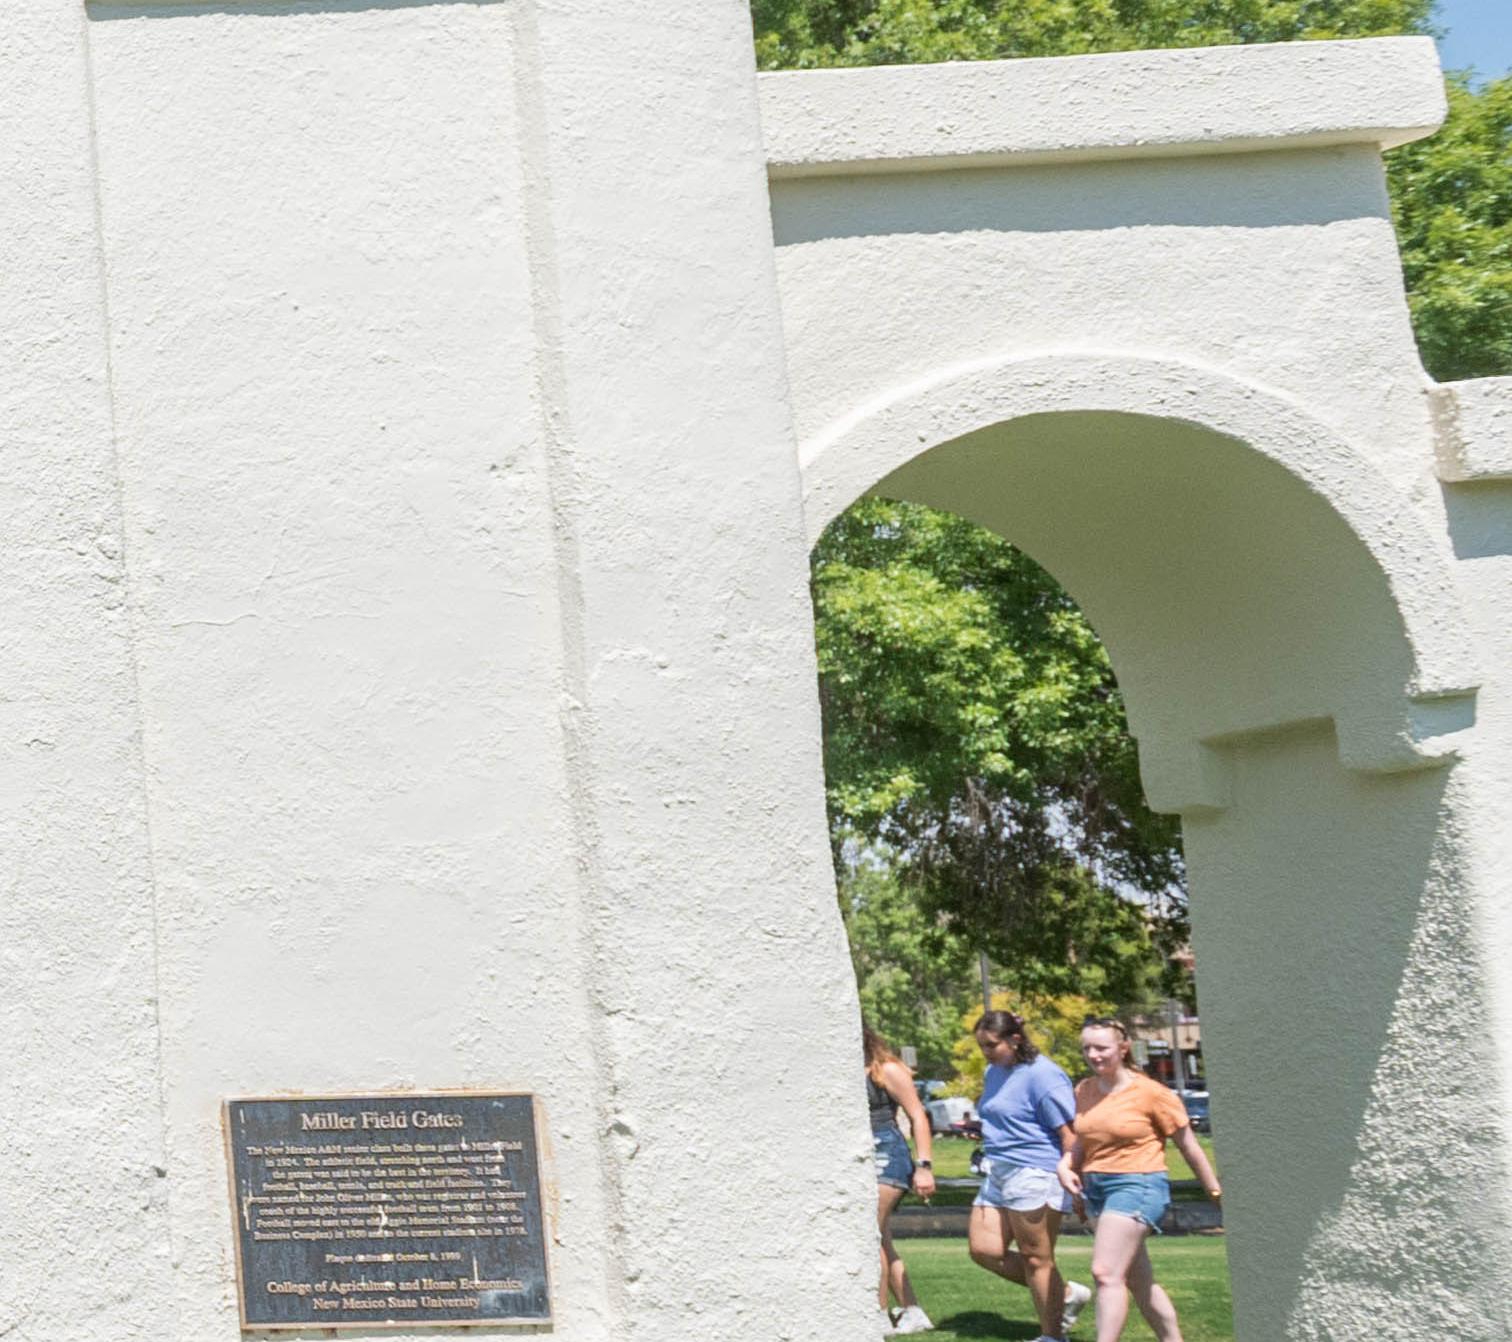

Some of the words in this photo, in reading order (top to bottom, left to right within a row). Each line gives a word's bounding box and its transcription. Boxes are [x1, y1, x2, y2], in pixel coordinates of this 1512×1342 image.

[300, 1112, 357, 1130] Miller
[360, 1110, 408, 1129] Field
[412, 1109, 463, 1128] Gates
[267, 1281, 312, 1295] College
[314, 1280, 328, 1291] of
[329, 1280, 396, 1294] Agriculture
[398, 1279, 420, 1290] and
[421, 1278, 457, 1289] Home
[458, 1276, 523, 1289] Economics
[312, 1297, 340, 1310] New
[341, 1297, 386, 1310] Mexico
[387, 1296, 418, 1308] State
[420, 1295, 480, 1309] University
